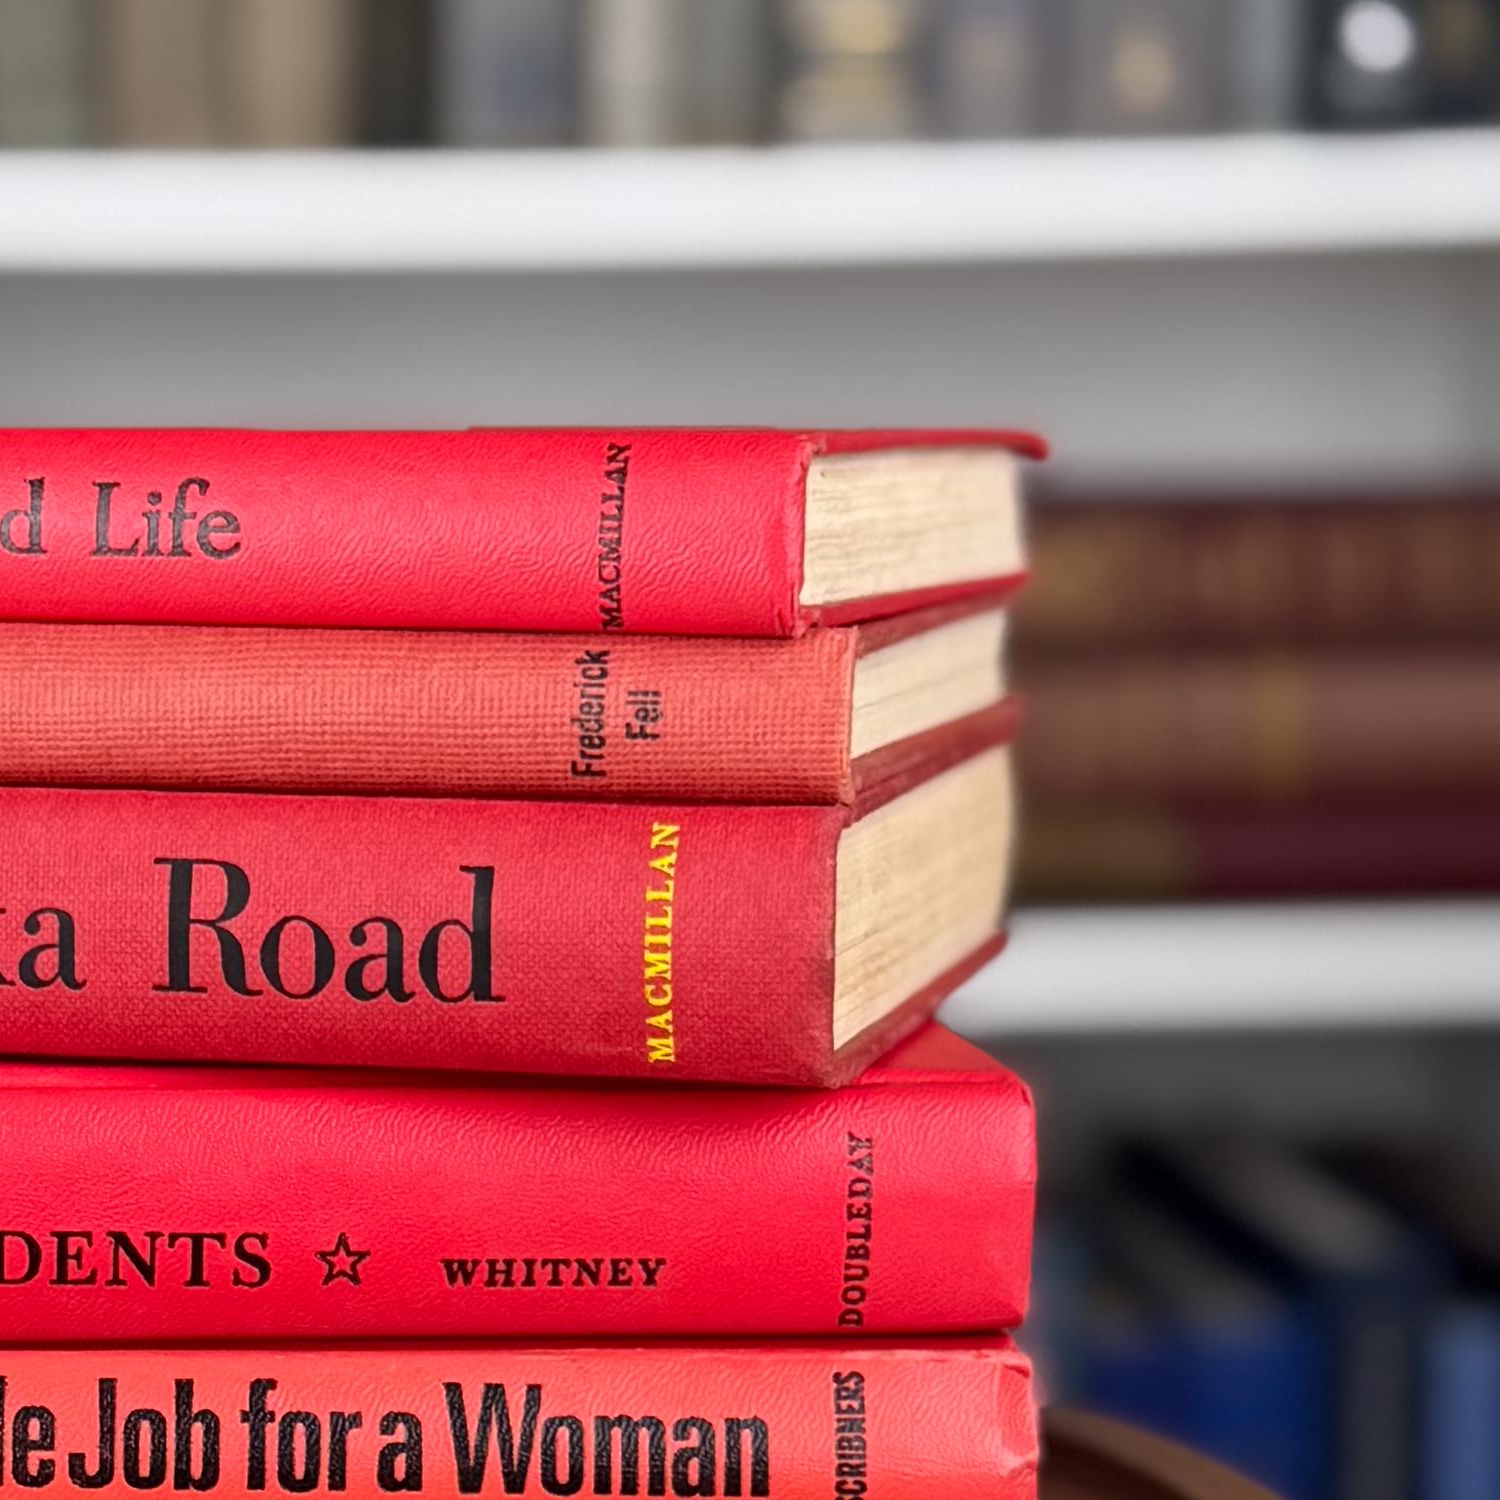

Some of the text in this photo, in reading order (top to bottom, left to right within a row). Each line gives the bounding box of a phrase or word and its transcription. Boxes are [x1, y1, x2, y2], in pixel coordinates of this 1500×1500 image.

[90, 476, 242, 560] Life
[599, 441, 632, 630] MACMILLAN
[571, 649, 610, 779] Frederick
[625, 690, 662, 741] Fell
[153, 856, 506, 1004] Road
[644, 820, 681, 1064] MACMILLAN
[440, 1258, 667, 1288] WHITNEY
[838, 1131, 873, 1327] DOUBLEDAY
[67, 1376, 221, 1492] Job
[240, 1377, 363, 1492] for
[377, 1410, 423, 1492] a
[441, 1381, 771, 1498] Woman
